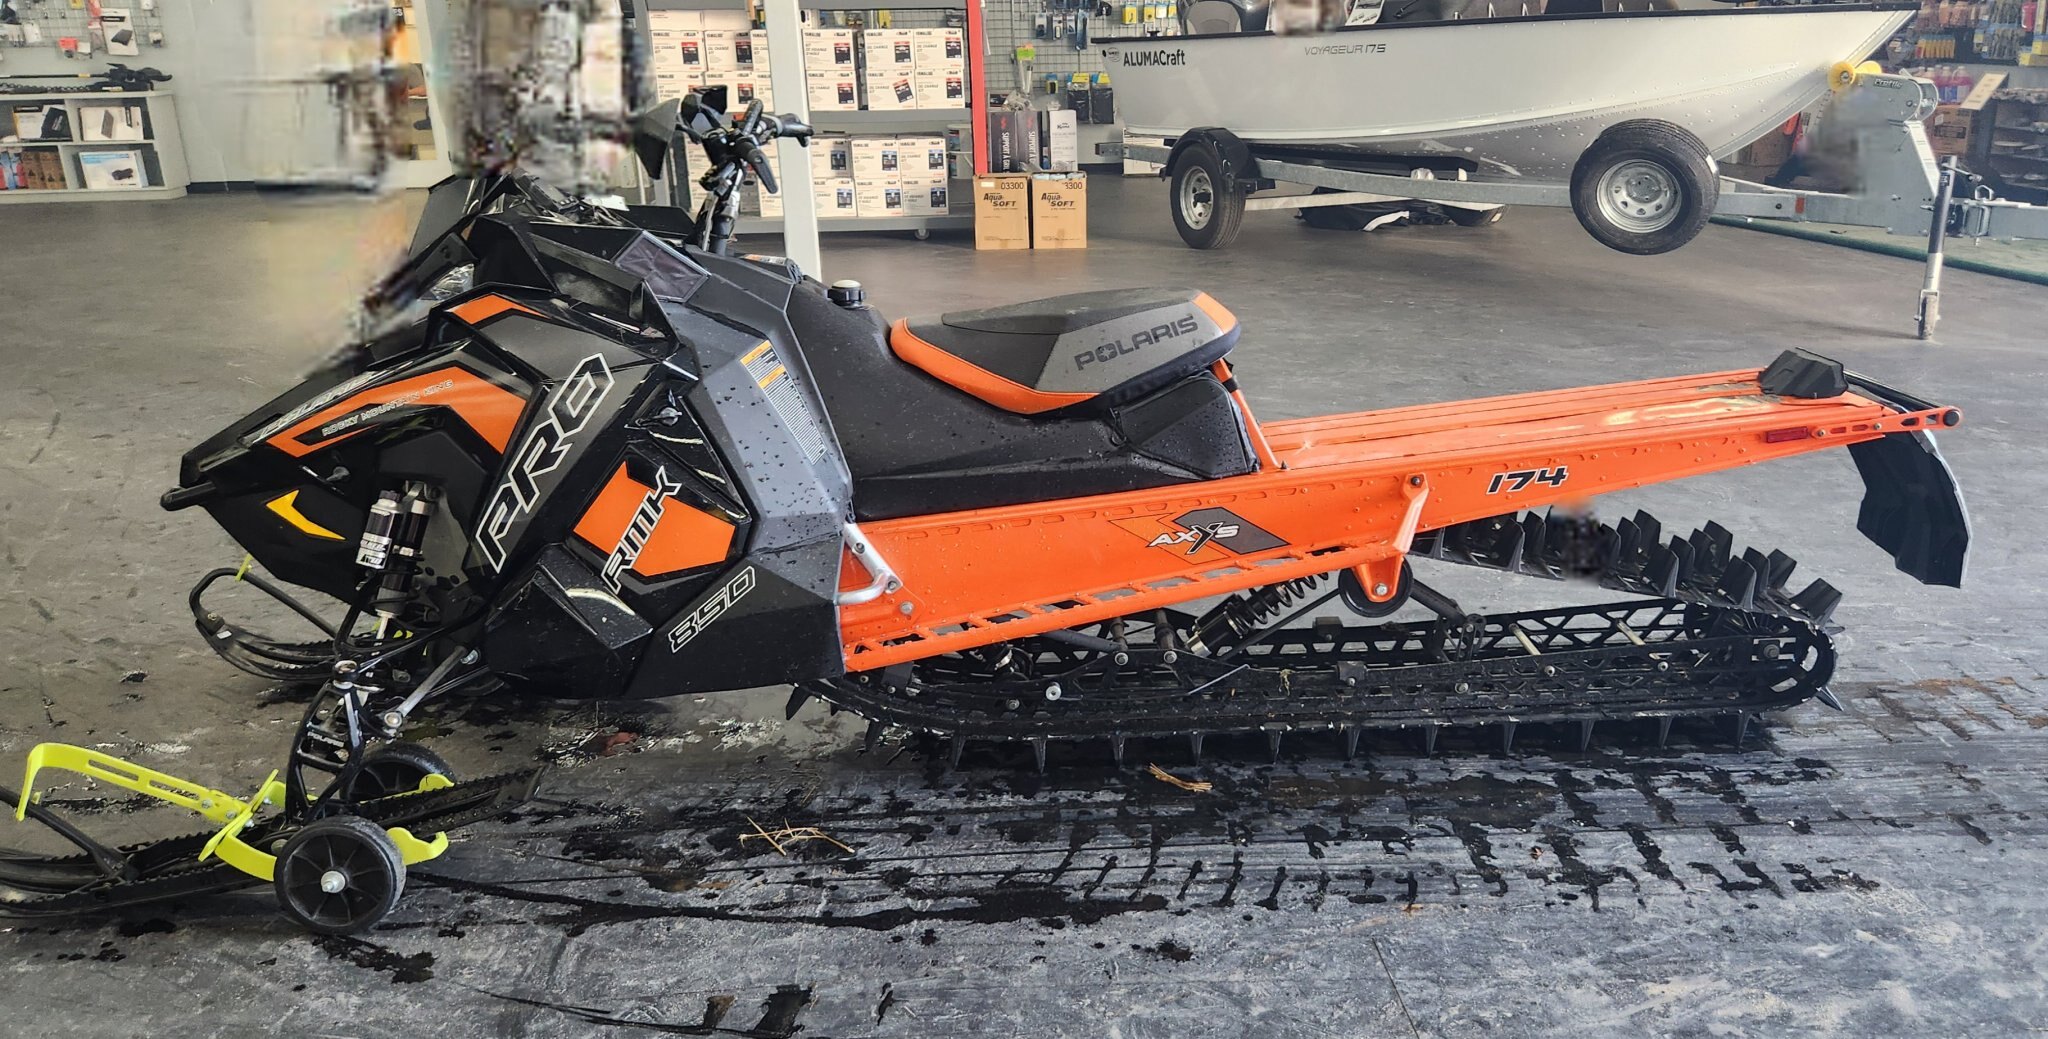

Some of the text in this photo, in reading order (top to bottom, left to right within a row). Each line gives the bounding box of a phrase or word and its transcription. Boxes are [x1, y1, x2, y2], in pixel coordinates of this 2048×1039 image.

[1123, 49, 1185, 66] ALUMACraft
[1304, 44, 1386, 55] VOYAGEUR 175
[1001, 182, 1024, 190] 03300
[1074, 313, 1198, 371] POLARIS
[322, 379, 454, 437] ROCKY MOUNTAIN KING
[475, 352, 616, 574] PRO
[1486, 466, 1569, 495] 174
[600, 465, 683, 595] RMK
[668, 565, 756, 654] 850
[307, 731, 345, 748] POLARIS
